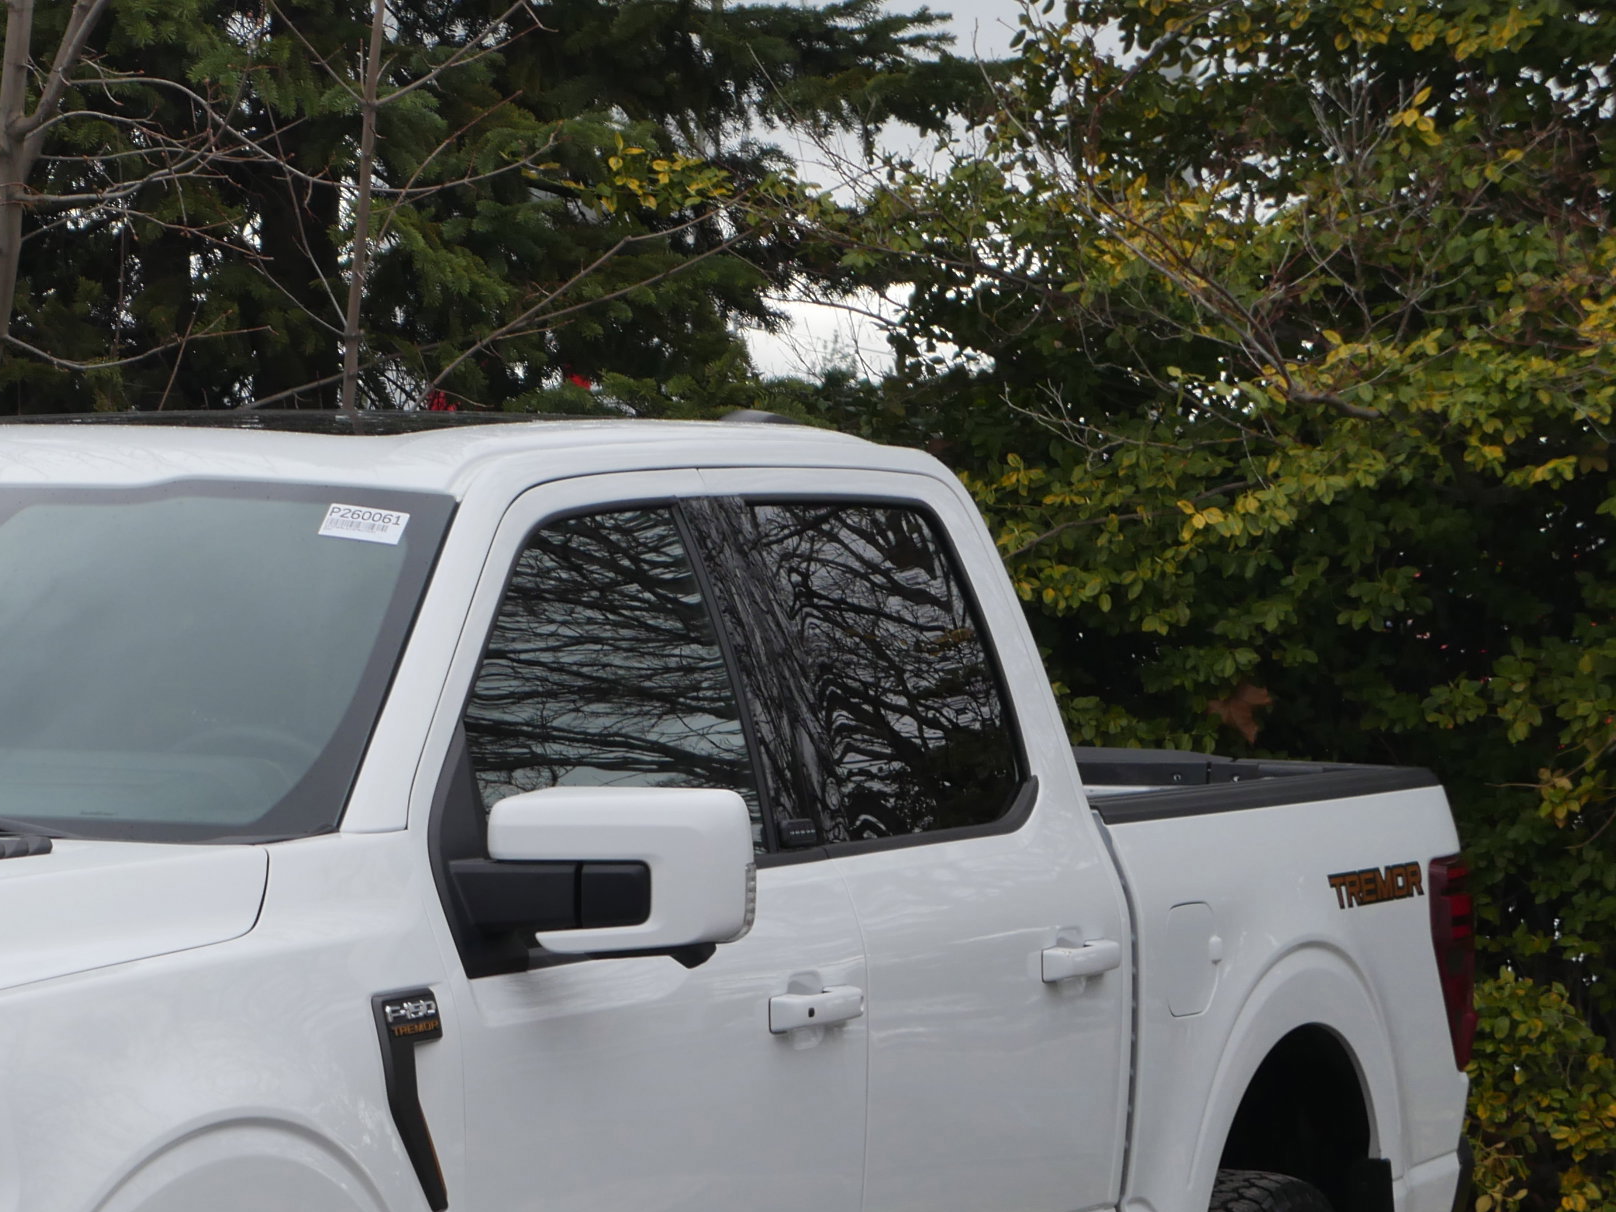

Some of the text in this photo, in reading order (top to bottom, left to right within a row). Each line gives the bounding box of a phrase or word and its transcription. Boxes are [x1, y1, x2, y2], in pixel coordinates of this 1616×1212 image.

[329, 506, 401, 526] P260061
[1327, 861, 1424, 909] TREMOR
[385, 998, 437, 1023] F-150
[391, 1020, 439, 1037] TREMOR
